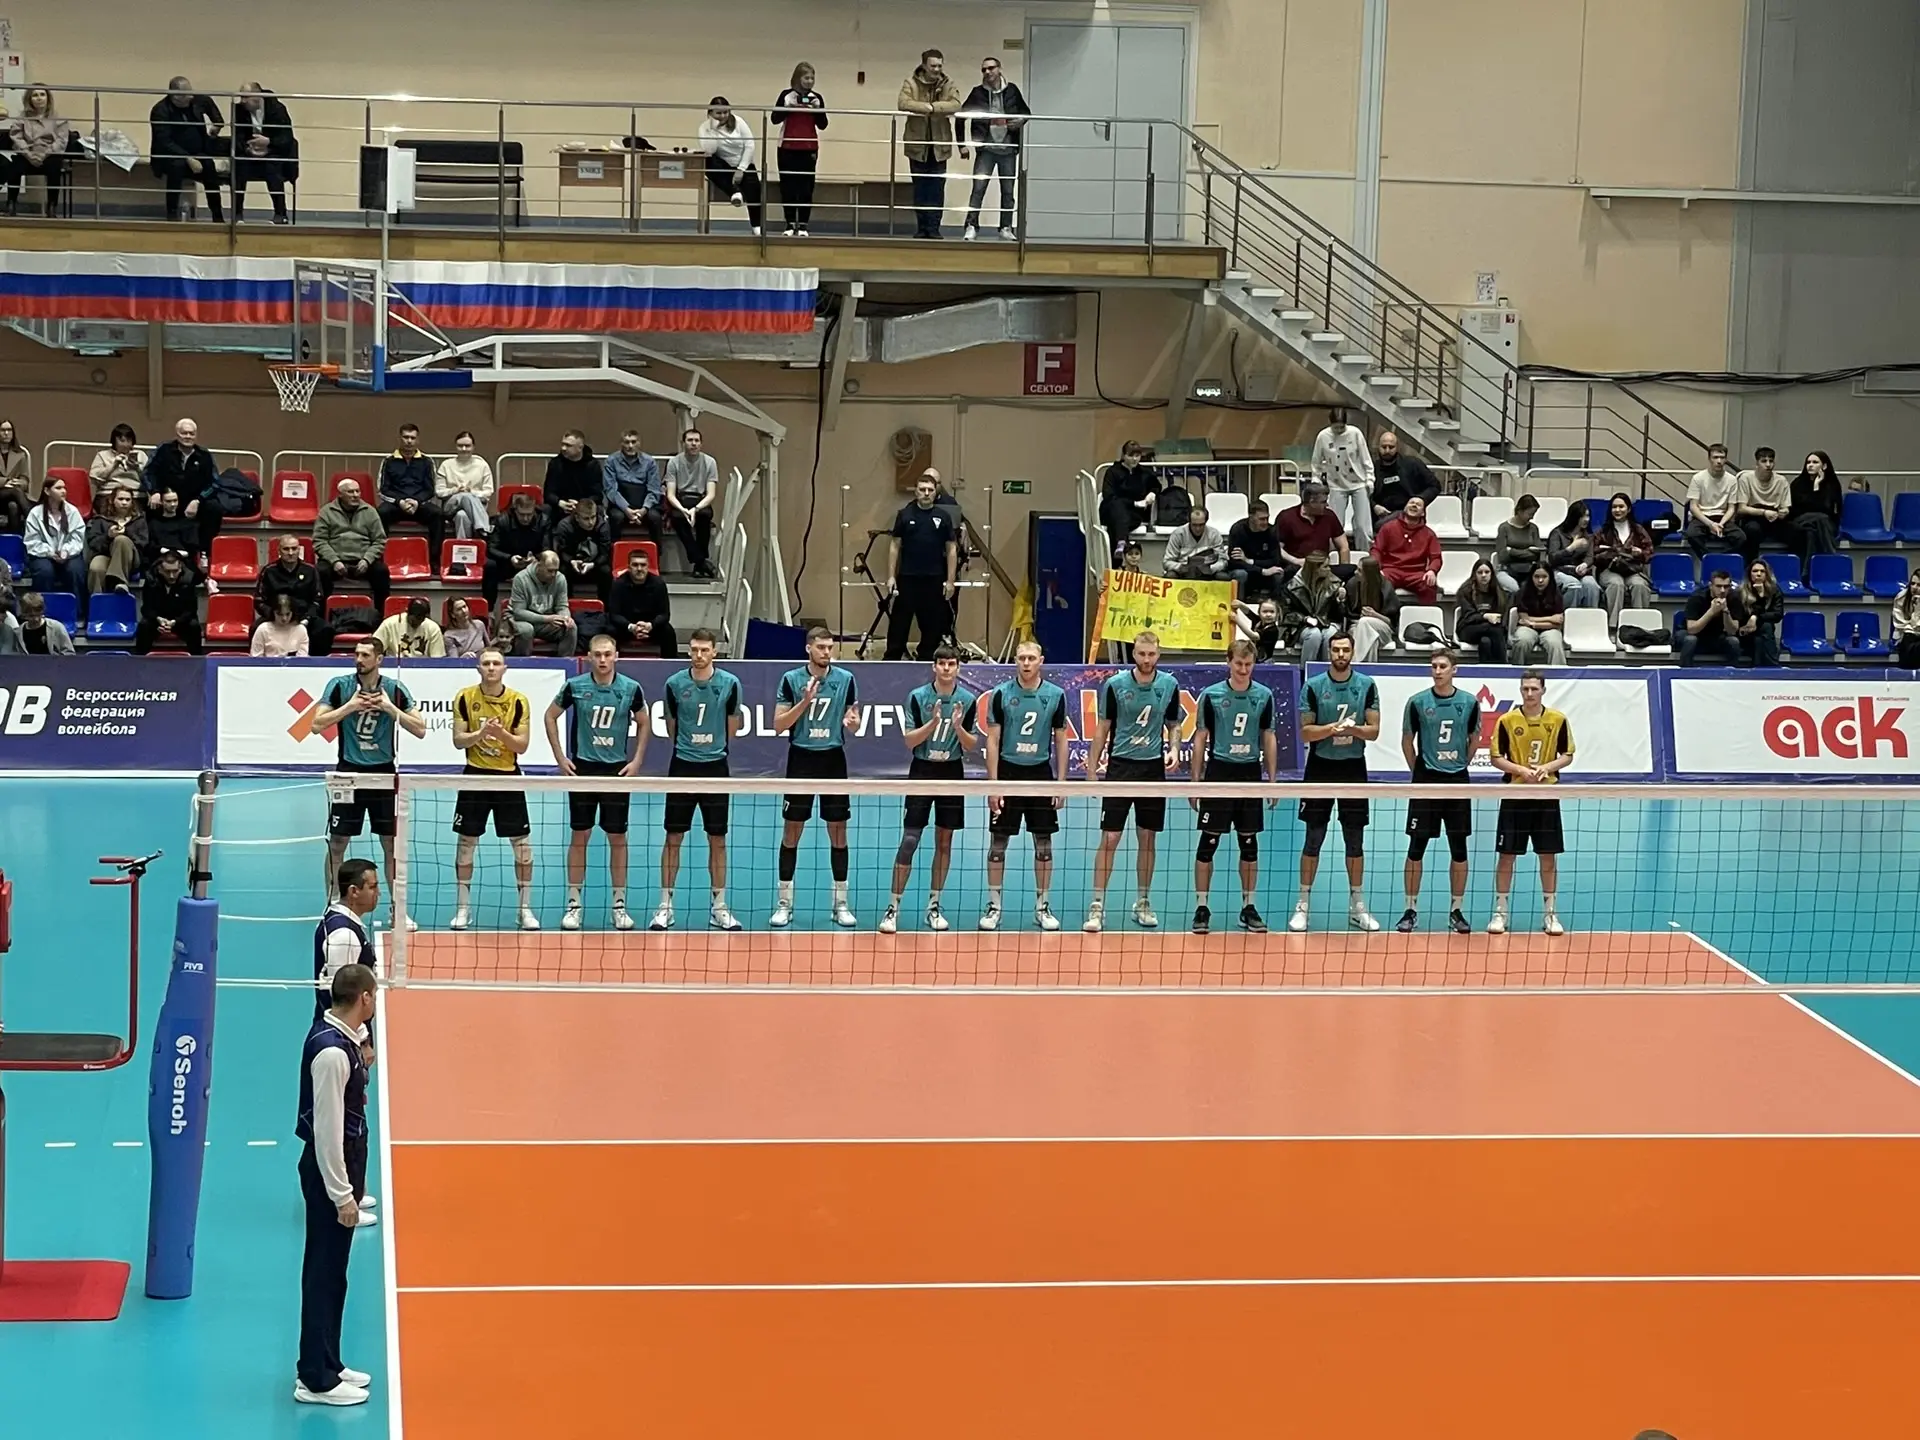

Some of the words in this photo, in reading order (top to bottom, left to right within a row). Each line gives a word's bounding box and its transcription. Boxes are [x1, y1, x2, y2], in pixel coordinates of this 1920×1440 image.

[1037, 346, 1063, 383] F
[1030, 384, 1069, 393] СЕКТОР
[1112, 571, 1173, 598] УНИВЕР
[66, 689, 178, 702] Всероссийская
[0, 686, 52, 735] В
[61, 705, 146, 719] федерация
[591, 705, 616, 729] 10
[696, 703, 707, 727] 1
[808, 698, 831, 721] 17
[1135, 705, 1152, 728] 4
[1336, 703, 1349, 722] 7
[58, 722, 137, 735] волейбола
[356, 711, 379, 734] 15
[932, 718, 951, 743] 11
[1020, 711, 1038, 736] 2
[1232, 712, 1249, 737] 9
[1438, 720, 1454, 744] 5
[1527, 740, 1543, 764] 3
[1202, 812, 1210, 824] 9
[1411, 818, 1418, 830] 5
[170, 1057, 192, 1135] Senoh
